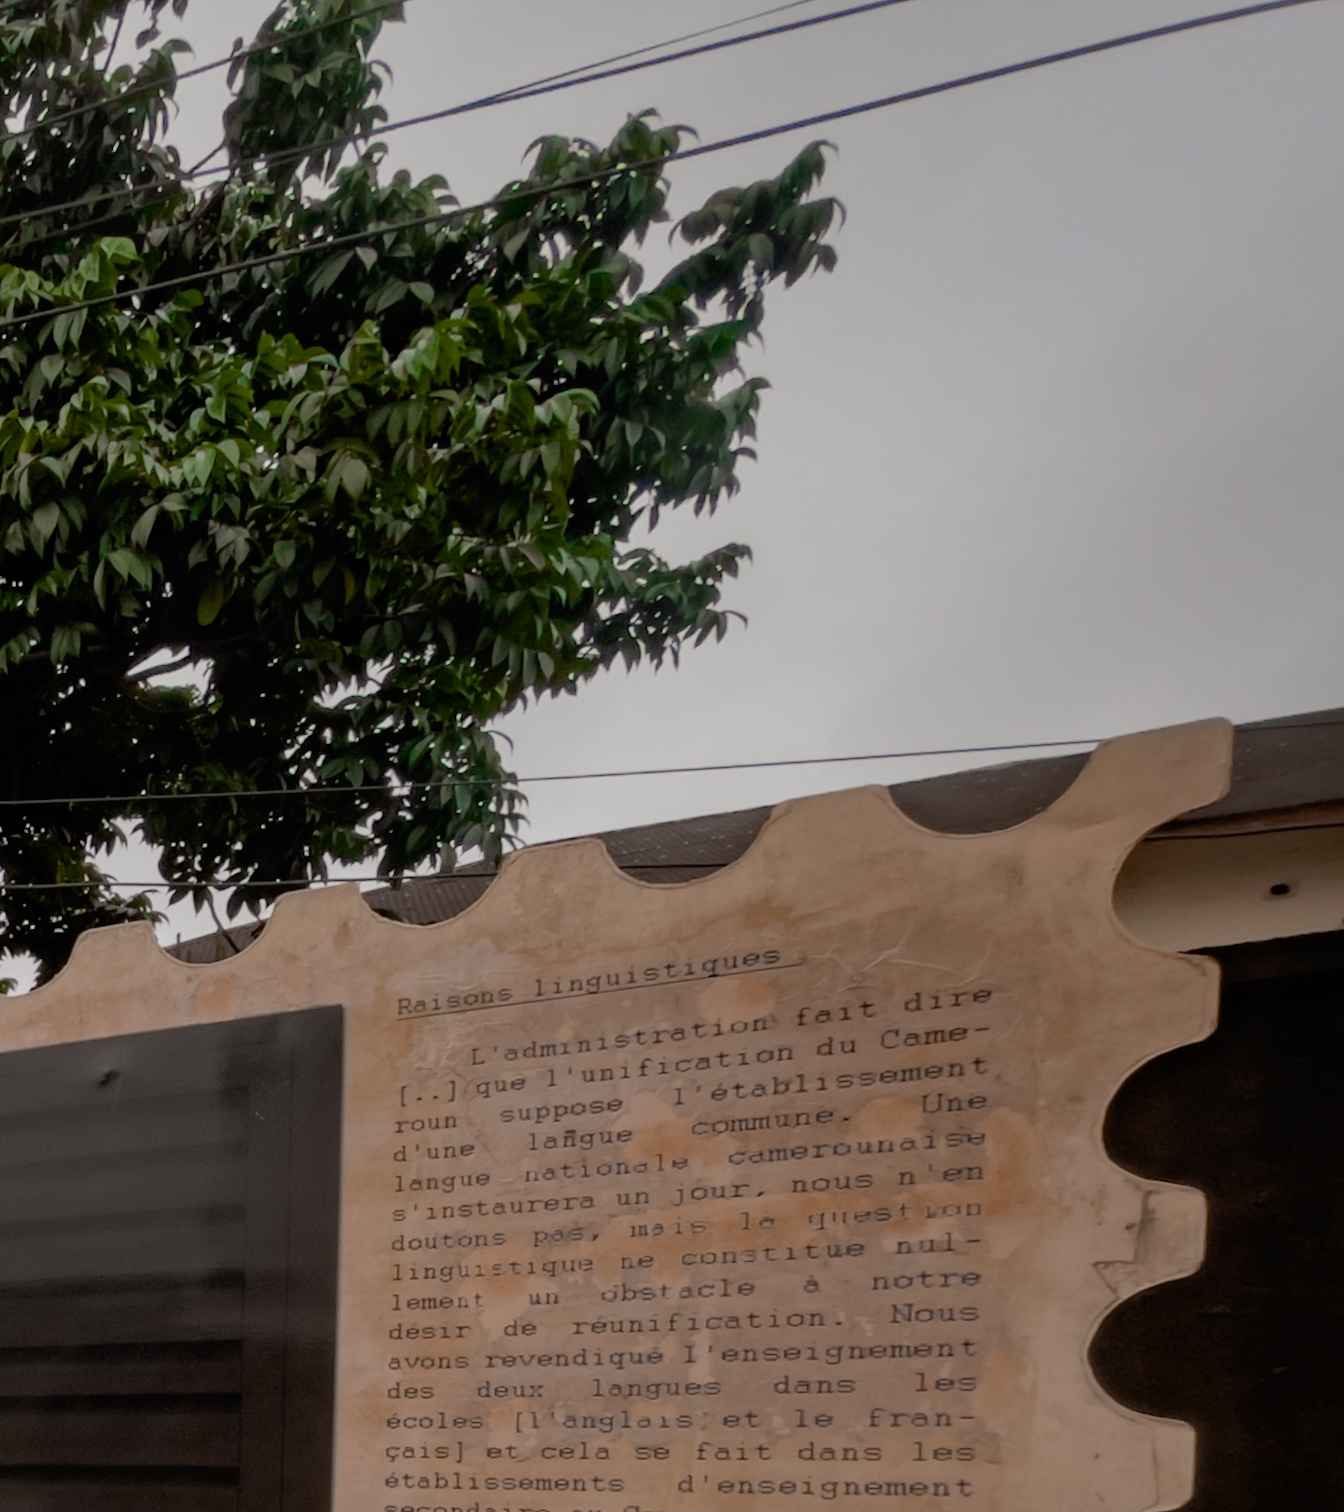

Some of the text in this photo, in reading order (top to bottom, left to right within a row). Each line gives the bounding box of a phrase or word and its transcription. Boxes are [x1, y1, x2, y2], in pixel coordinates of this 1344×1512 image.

[397, 948, 782, 1016] Raisons linguistiques
[471, 989, 993, 1066] L'administration fait dire
[475, 1076, 527, 1098] que
[547, 1044, 794, 1087] l'unification
[816, 1036, 856, 1056] du
[880, 1027, 990, 1049] Came-
[392, 1142, 476, 1163] d'une
[691, 1110, 852, 1135] commune.
[921, 1093, 987, 1114] Une
[394, 1115, 458, 1134] roun
[500, 1099, 623, 1124] suppose
[395, 1133, 986, 1194] langue nationale camerounaise
[392, 1164, 984, 1222] s'instaurera un jour, nous n'en
[391, 1203, 981, 1252] doutons pas, mais la question
[392, 1232, 981, 1283] linguistique ne constitue nul-
[392, 1293, 483, 1311] lement
[528, 1292, 560, 1306] un
[600, 1278, 755, 1303] obstacle
[871, 1270, 982, 1291] notre
[504, 1320, 537, 1337] de
[889, 1303, 980, 1324] Nous
[388, 1356, 469, 1371] avons
[684, 1339, 976, 1365] l'enseignement
[387, 1372, 976, 1400] des deux langues dans les
[386, 1412, 483, 1429] écoles
[723, 1410, 760, 1428] et
[795, 1409, 834, 1428] le
[869, 1408, 976, 1428] fran-
[385, 1441, 975, 1464] çais] et cela se fait dans les
[385, 1472, 974, 1500] établissements d'enseignement
